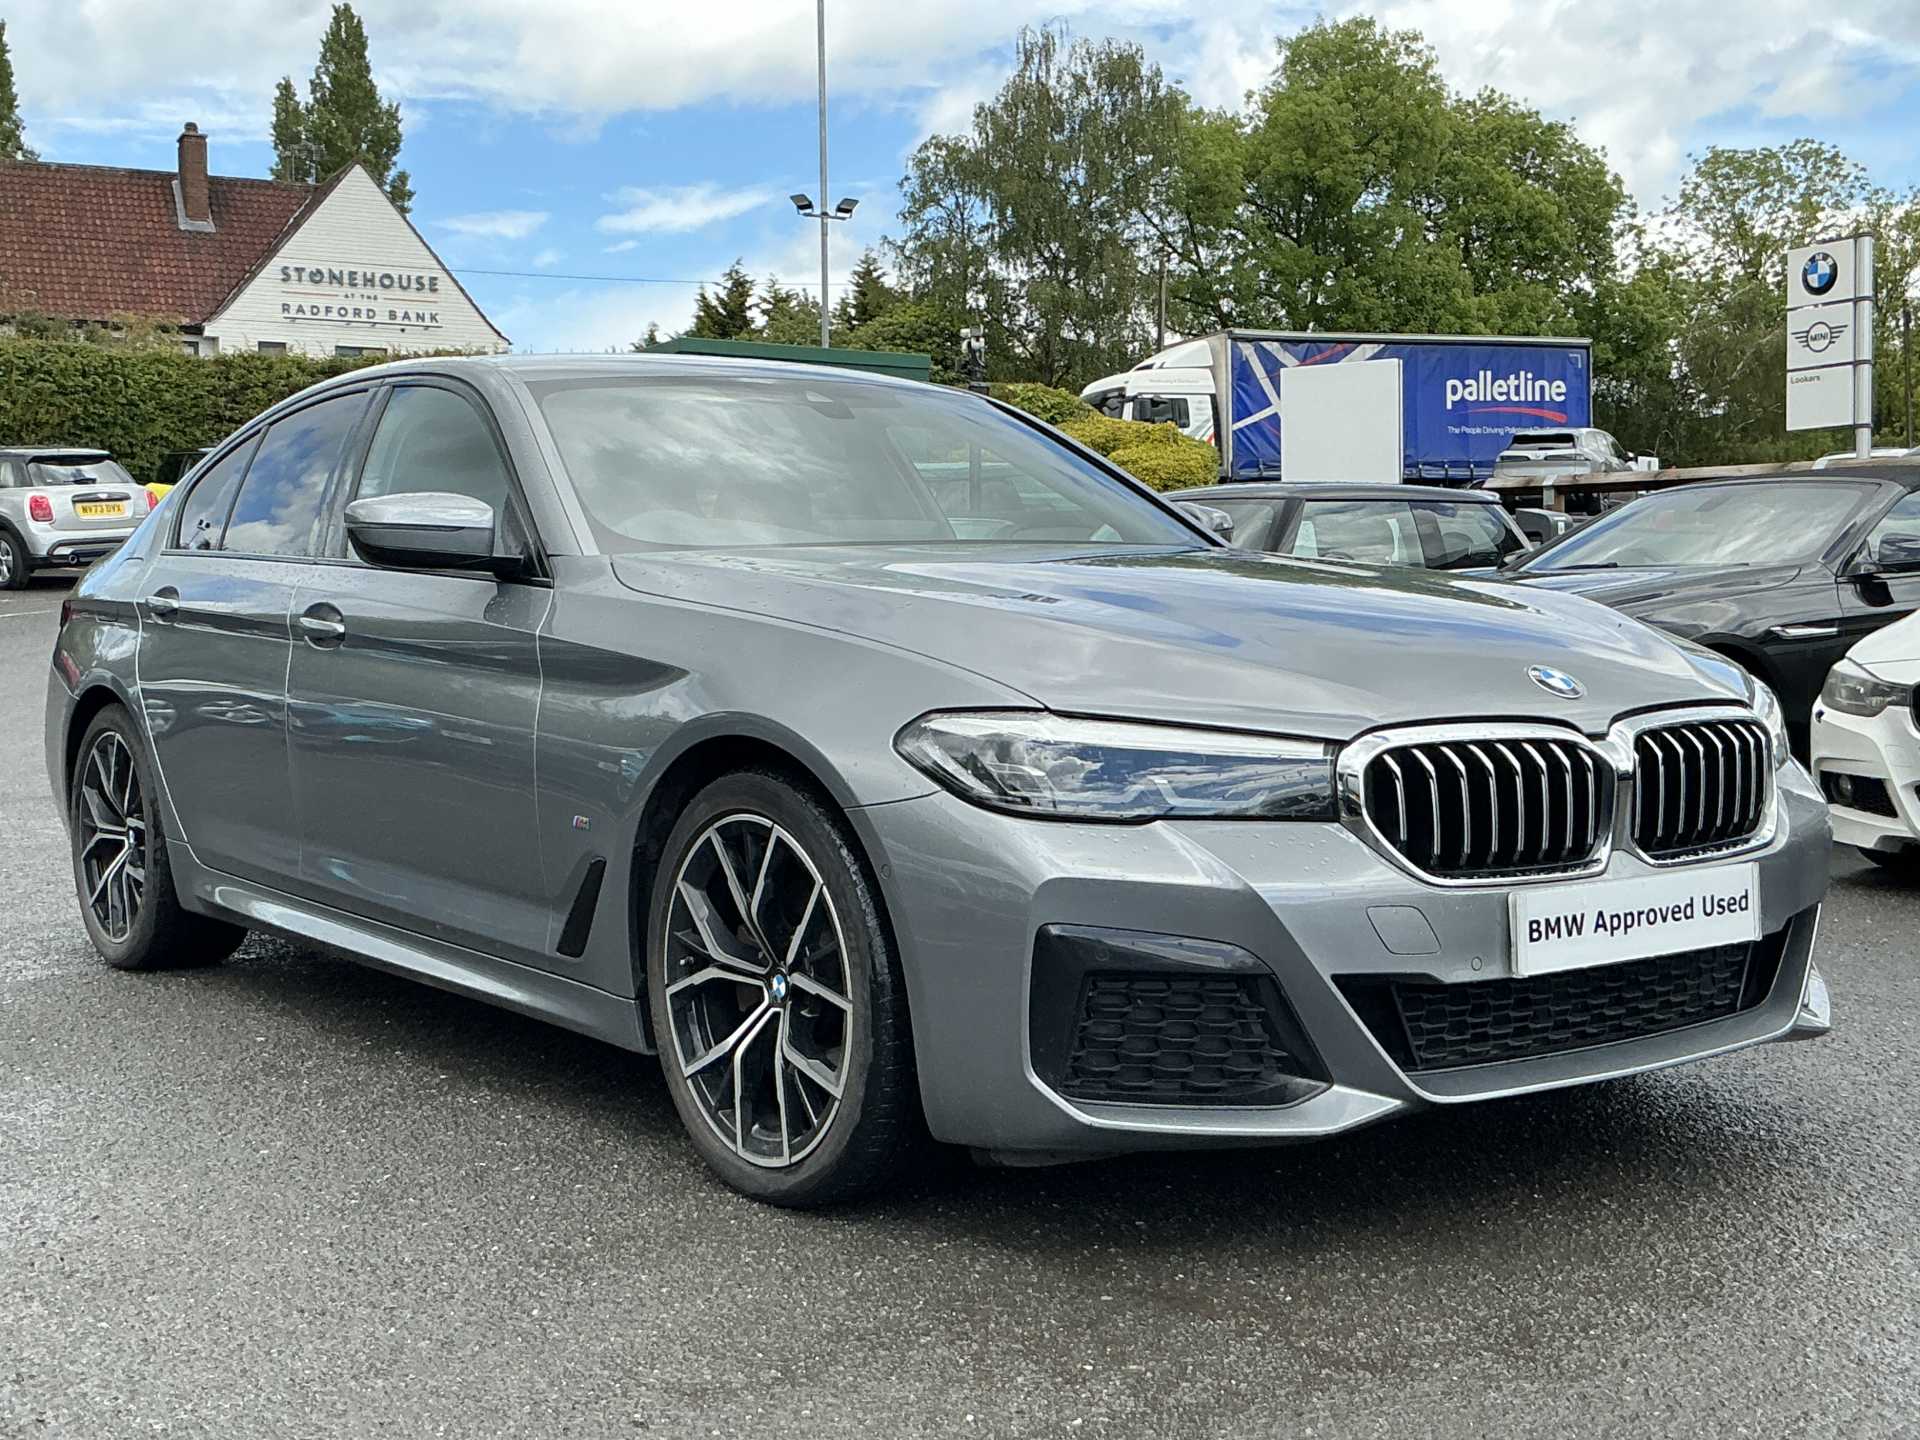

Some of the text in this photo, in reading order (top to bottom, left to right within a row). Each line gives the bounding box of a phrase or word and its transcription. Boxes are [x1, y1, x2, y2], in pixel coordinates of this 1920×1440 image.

[281, 266, 439, 292] STONEHOUSE
[282, 303, 439, 324] RADFORD BANK
[1809, 331, 1829, 341] MINI
[1446, 369, 1567, 410] palletline
[1790, 375, 1821, 385] Lookers
[1447, 426, 1460, 434] The
[1461, 426, 1481, 435] People
[1482, 426, 1504, 436] Driving
[1528, 889, 1750, 943] BMW Approved Used
